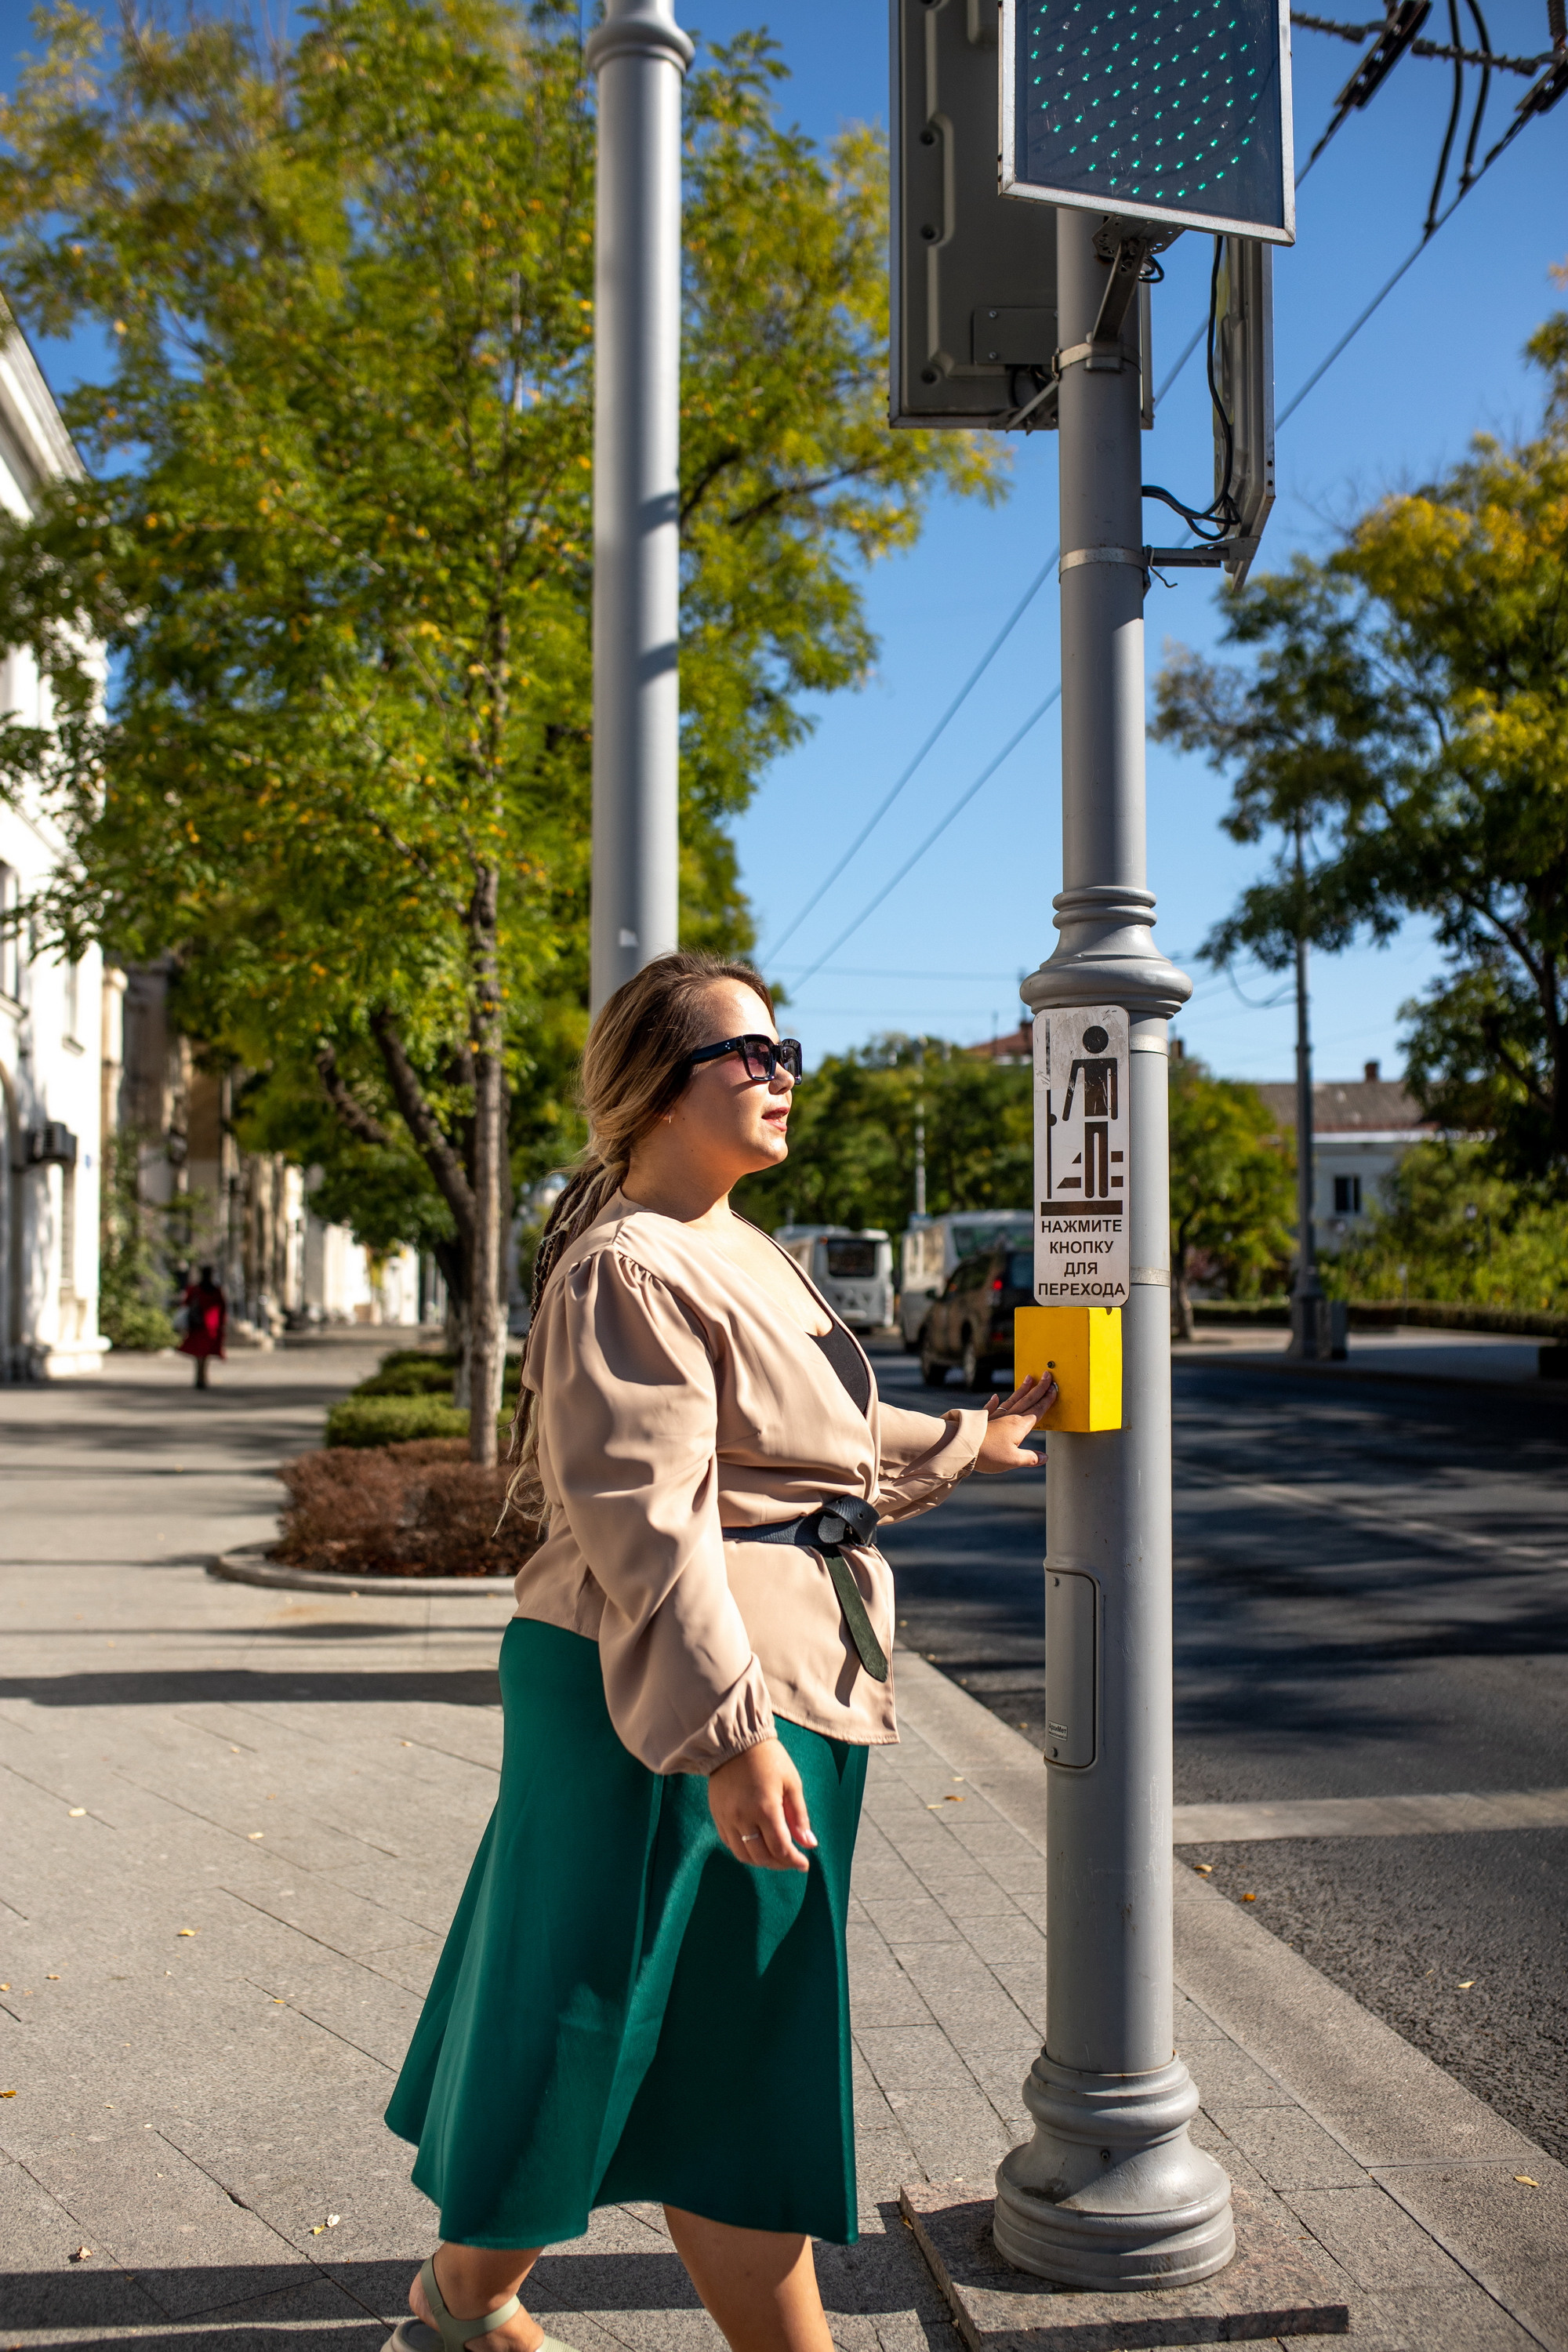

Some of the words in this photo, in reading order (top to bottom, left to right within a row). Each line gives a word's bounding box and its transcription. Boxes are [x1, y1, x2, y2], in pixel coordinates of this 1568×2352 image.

[1041, 1219, 1123, 1233] НАЖМИТЕ
[1050, 1240, 1114, 1254] КНОПКУ
[1064, 1261, 1098, 1278] ДЛЯ
[1038, 1283, 1126, 1298] ПЕРЕХОДА
